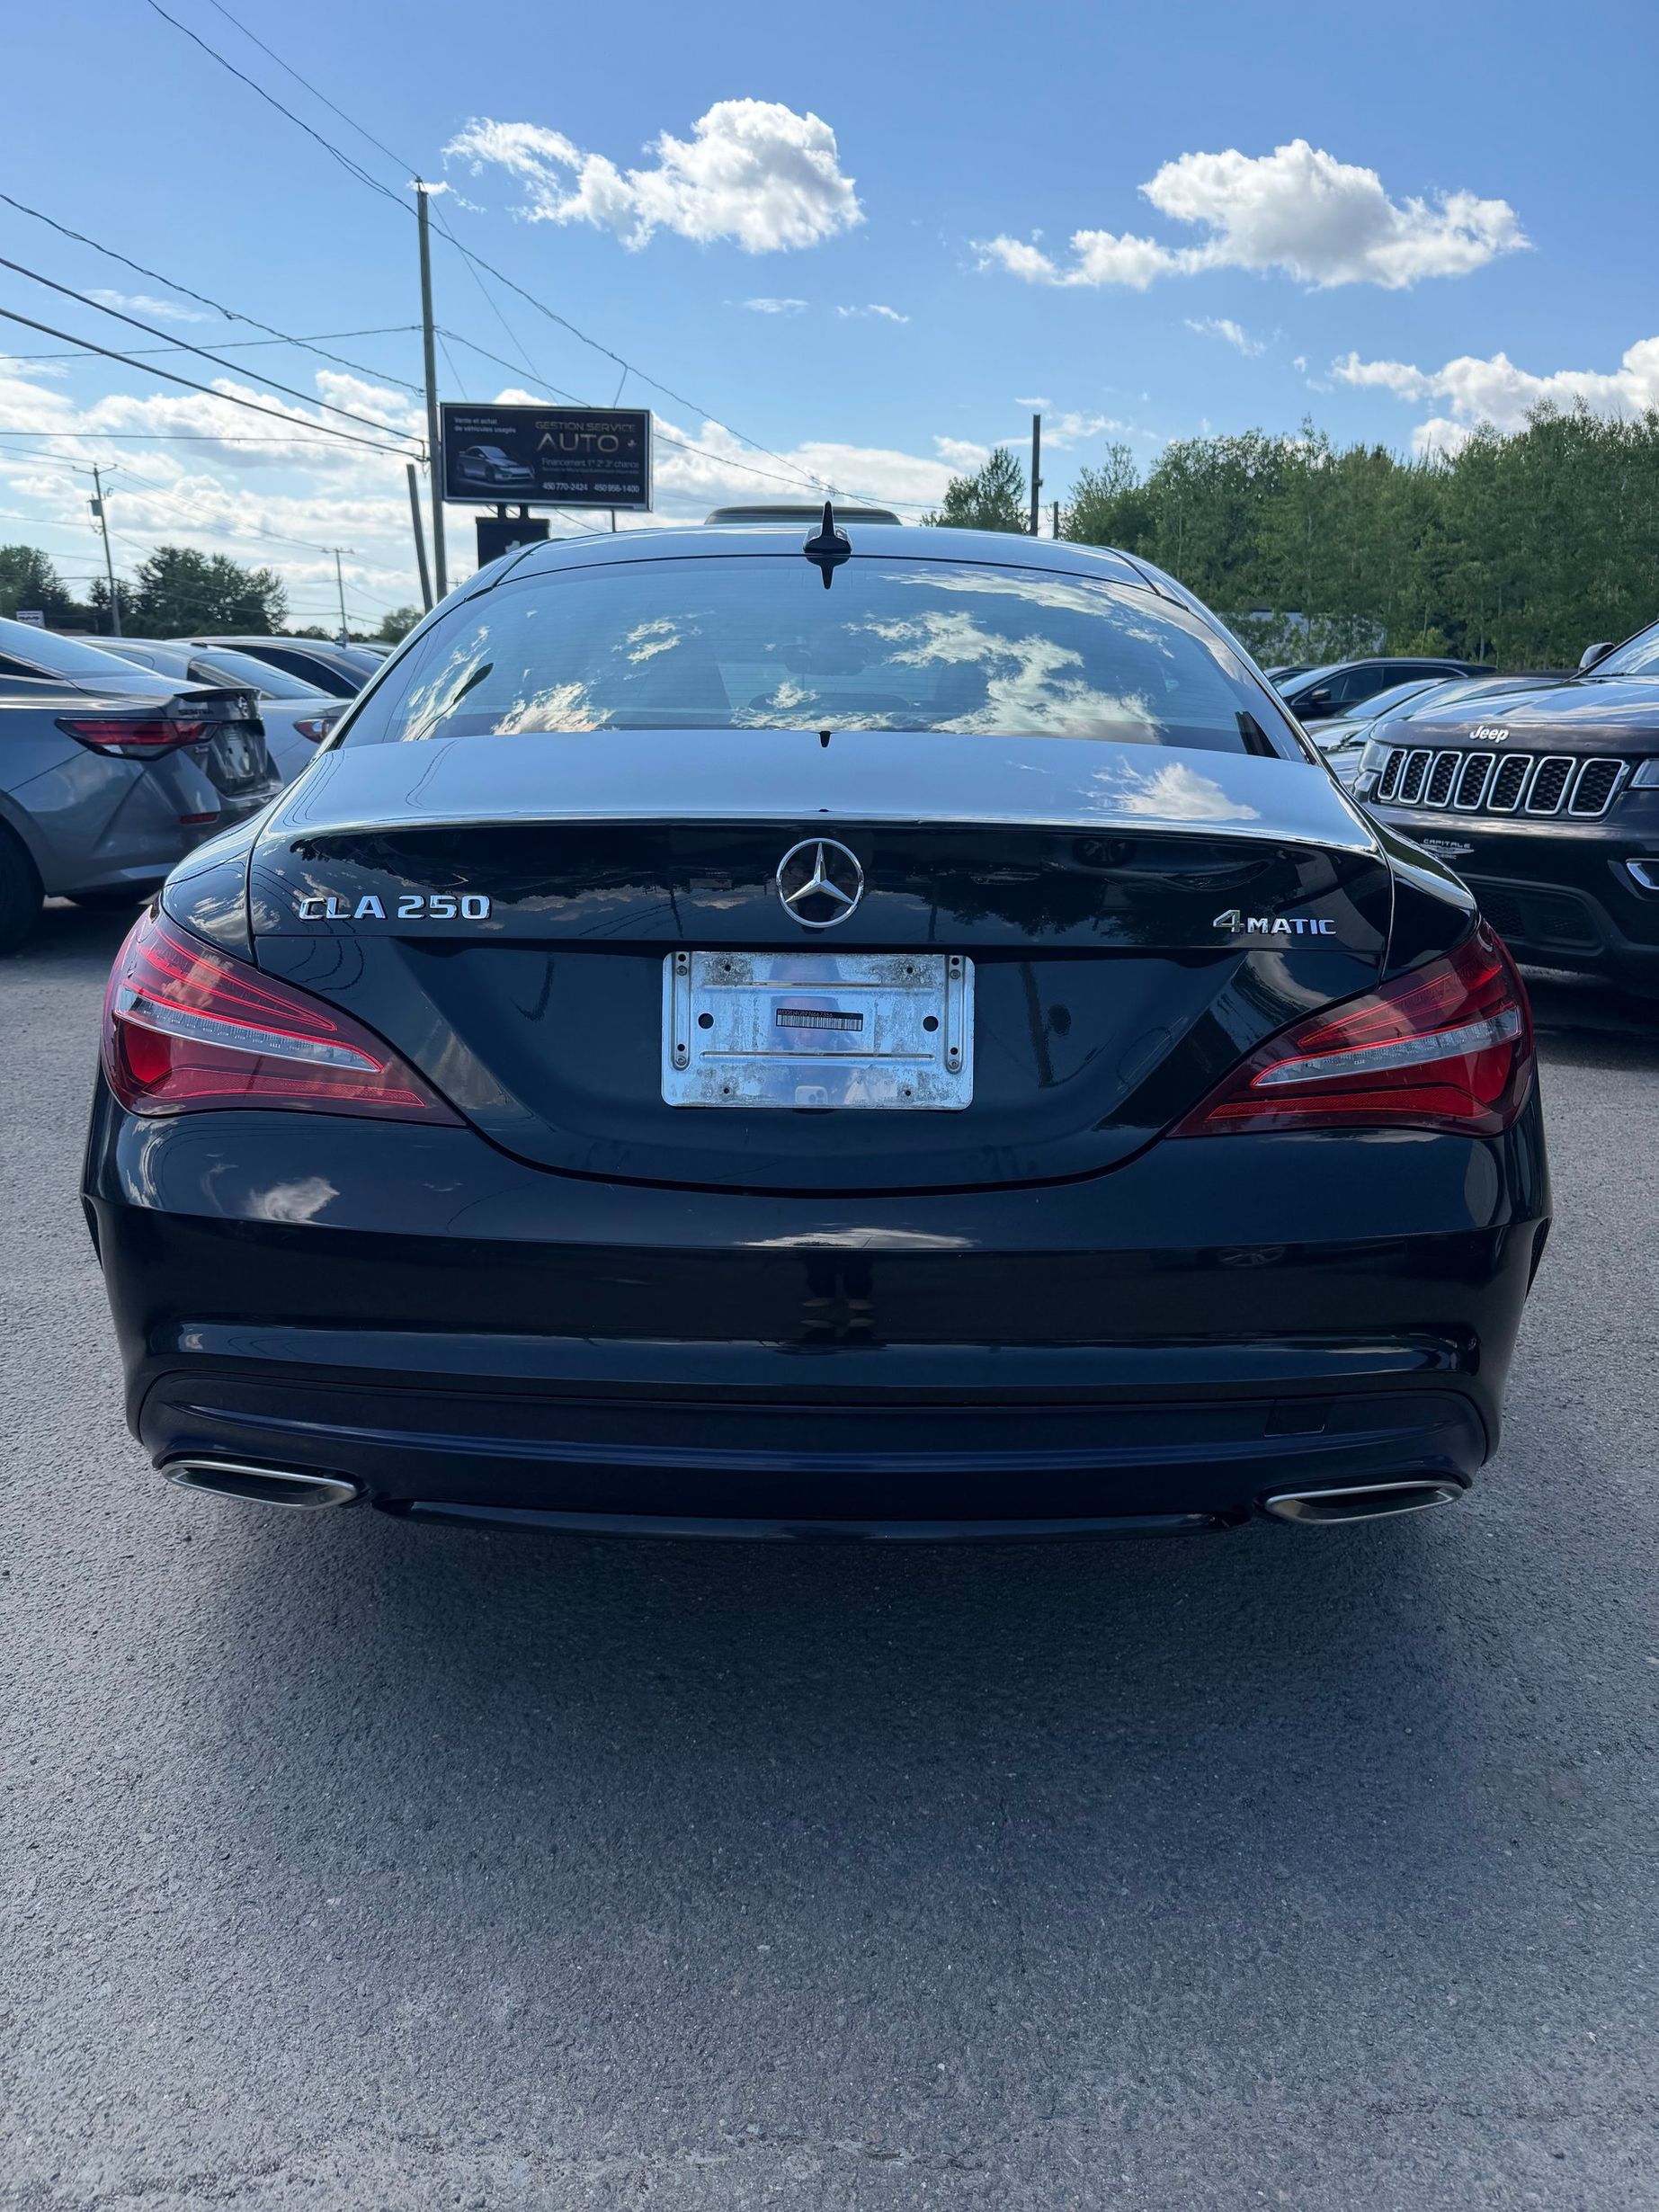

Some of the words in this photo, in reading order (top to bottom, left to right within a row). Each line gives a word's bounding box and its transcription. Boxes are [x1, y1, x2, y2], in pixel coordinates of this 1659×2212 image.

[535, 421, 584, 432] GESTION
[586, 423, 637, 433] SERVICE
[536, 433, 619, 452] AUTO
[541, 457, 585, 467] Financement
[614, 460, 640, 468] chance
[542, 482, 555, 490] 450
[594, 484, 607, 492] 450
[1469, 725, 1510, 744] Jeep
[1423, 838, 1471, 849] CAPITALE
[299, 896, 386, 920] CLA
[397, 895, 490, 920] 250
[1212, 909, 1336, 934] 4MATIC
